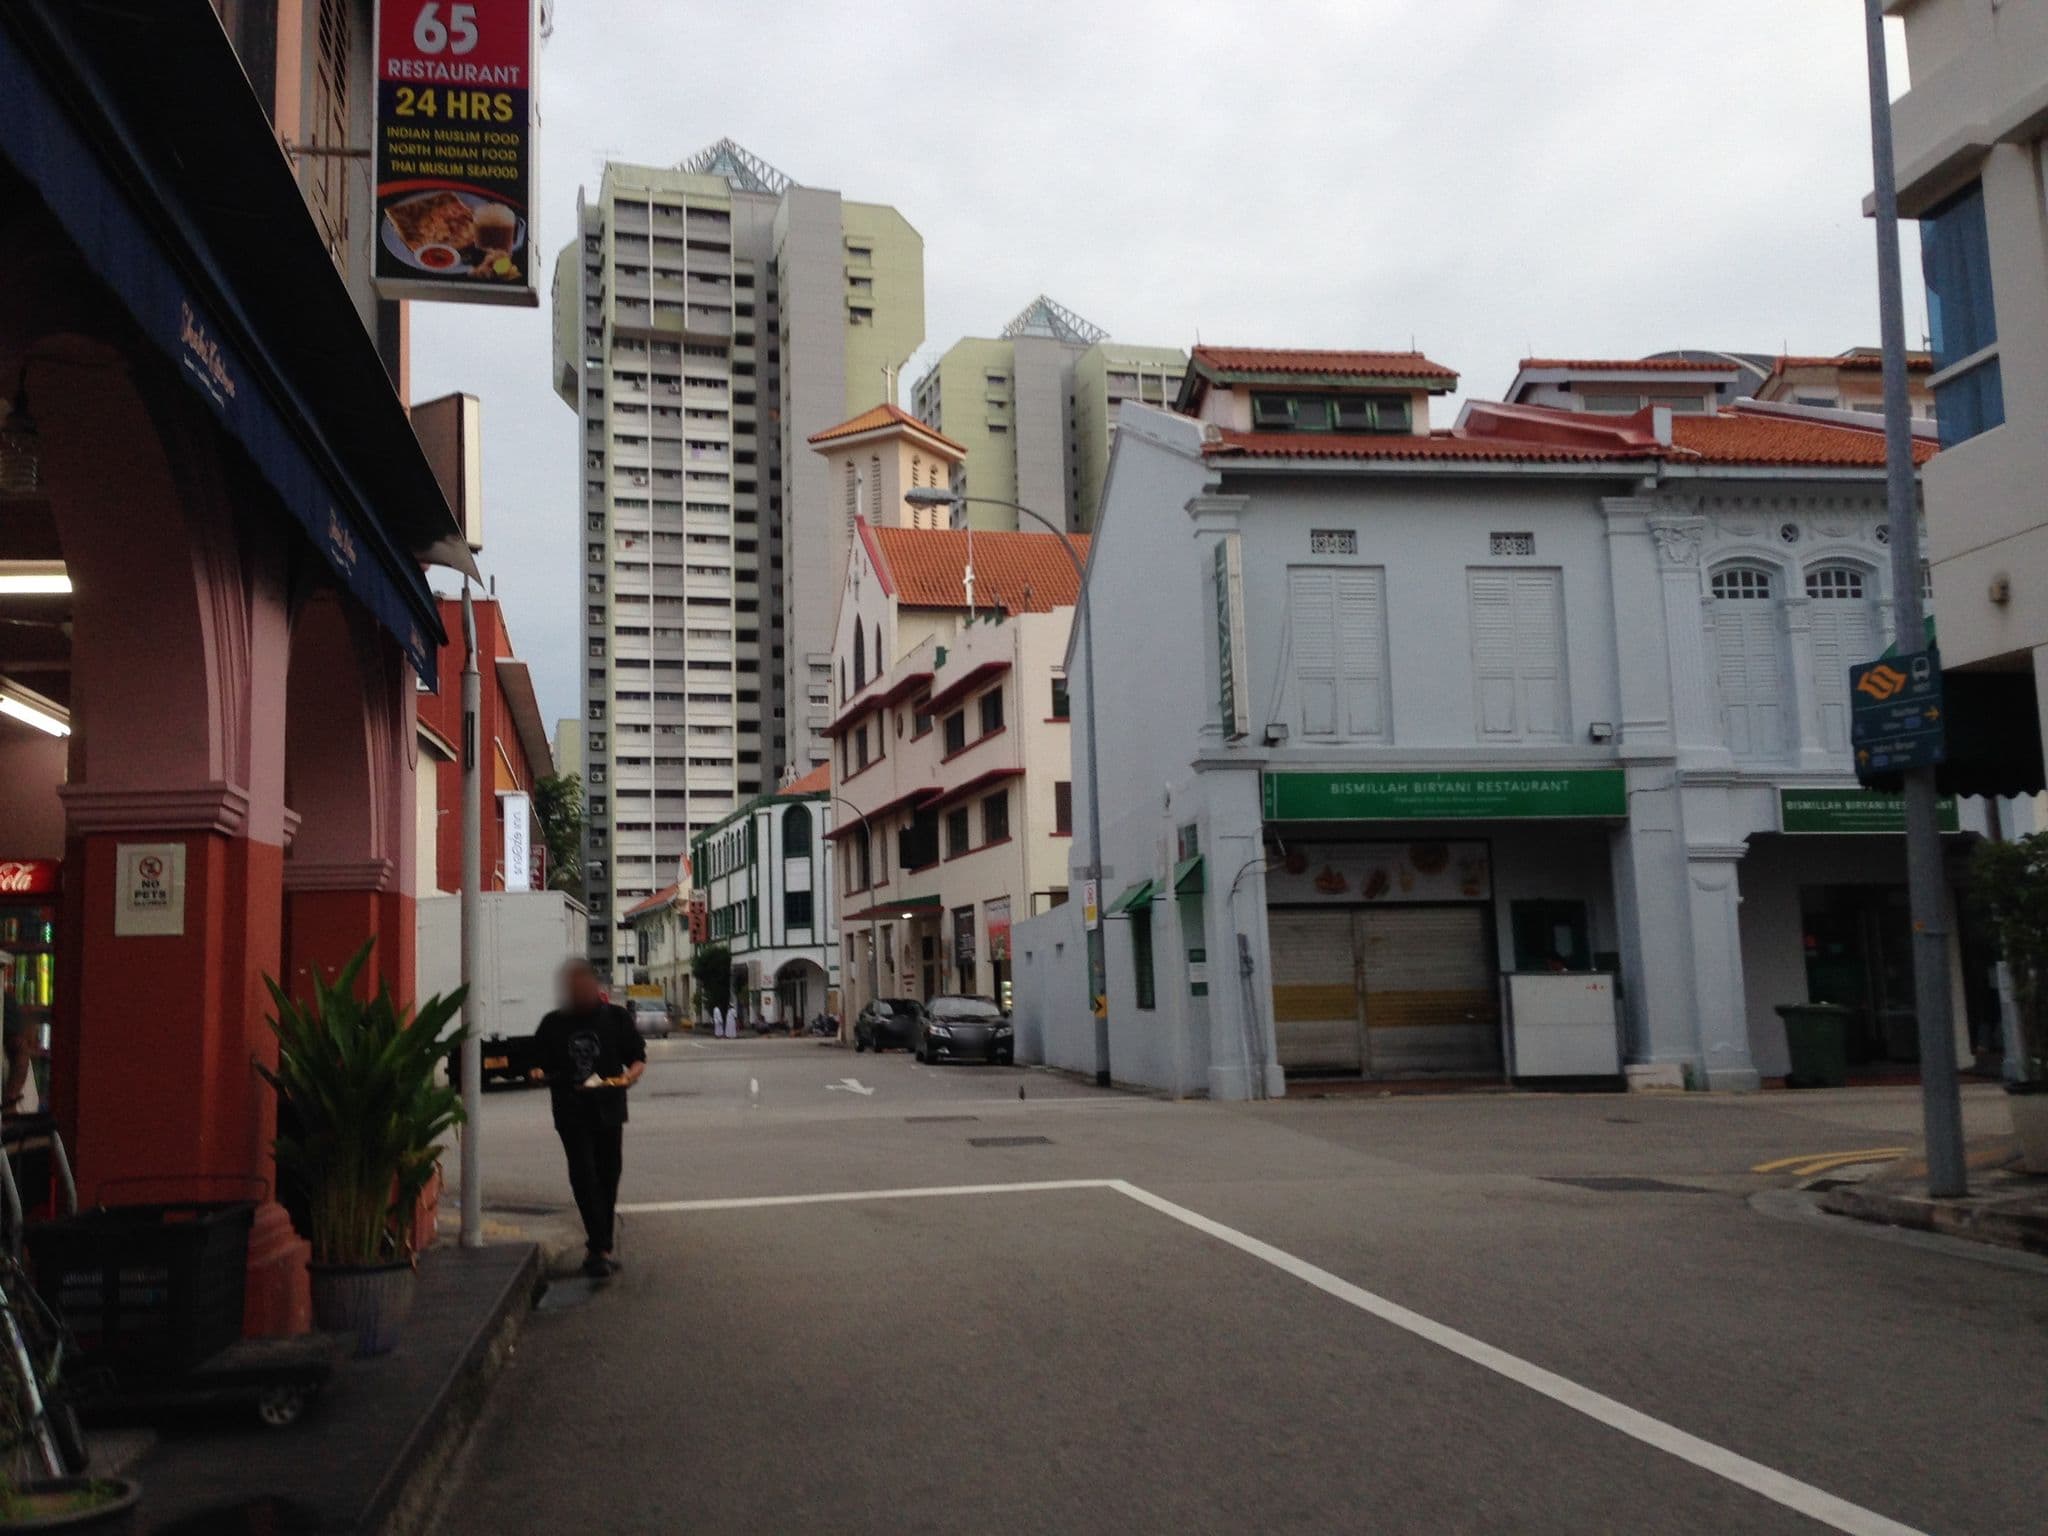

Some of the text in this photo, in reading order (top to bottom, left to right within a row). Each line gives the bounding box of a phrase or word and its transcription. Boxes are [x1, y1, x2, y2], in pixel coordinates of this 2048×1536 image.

[413, 1, 479, 55] 65
[387, 58, 521, 84] RESTAURANT
[395, 86, 514, 123] 24 HRS
[386, 126, 520, 146] INDIAN MUSLIM FOOD
[388, 143, 518, 162] NORTH INDIAN FOOD
[391, 159, 519, 180] THAI MUSLIM SEAFOOD
[1330, 780, 1570, 795] BISMILLAH BIRYANI RESTAURANT
[141, 880, 160, 889] NO
[134, 890, 167, 900] PETS
